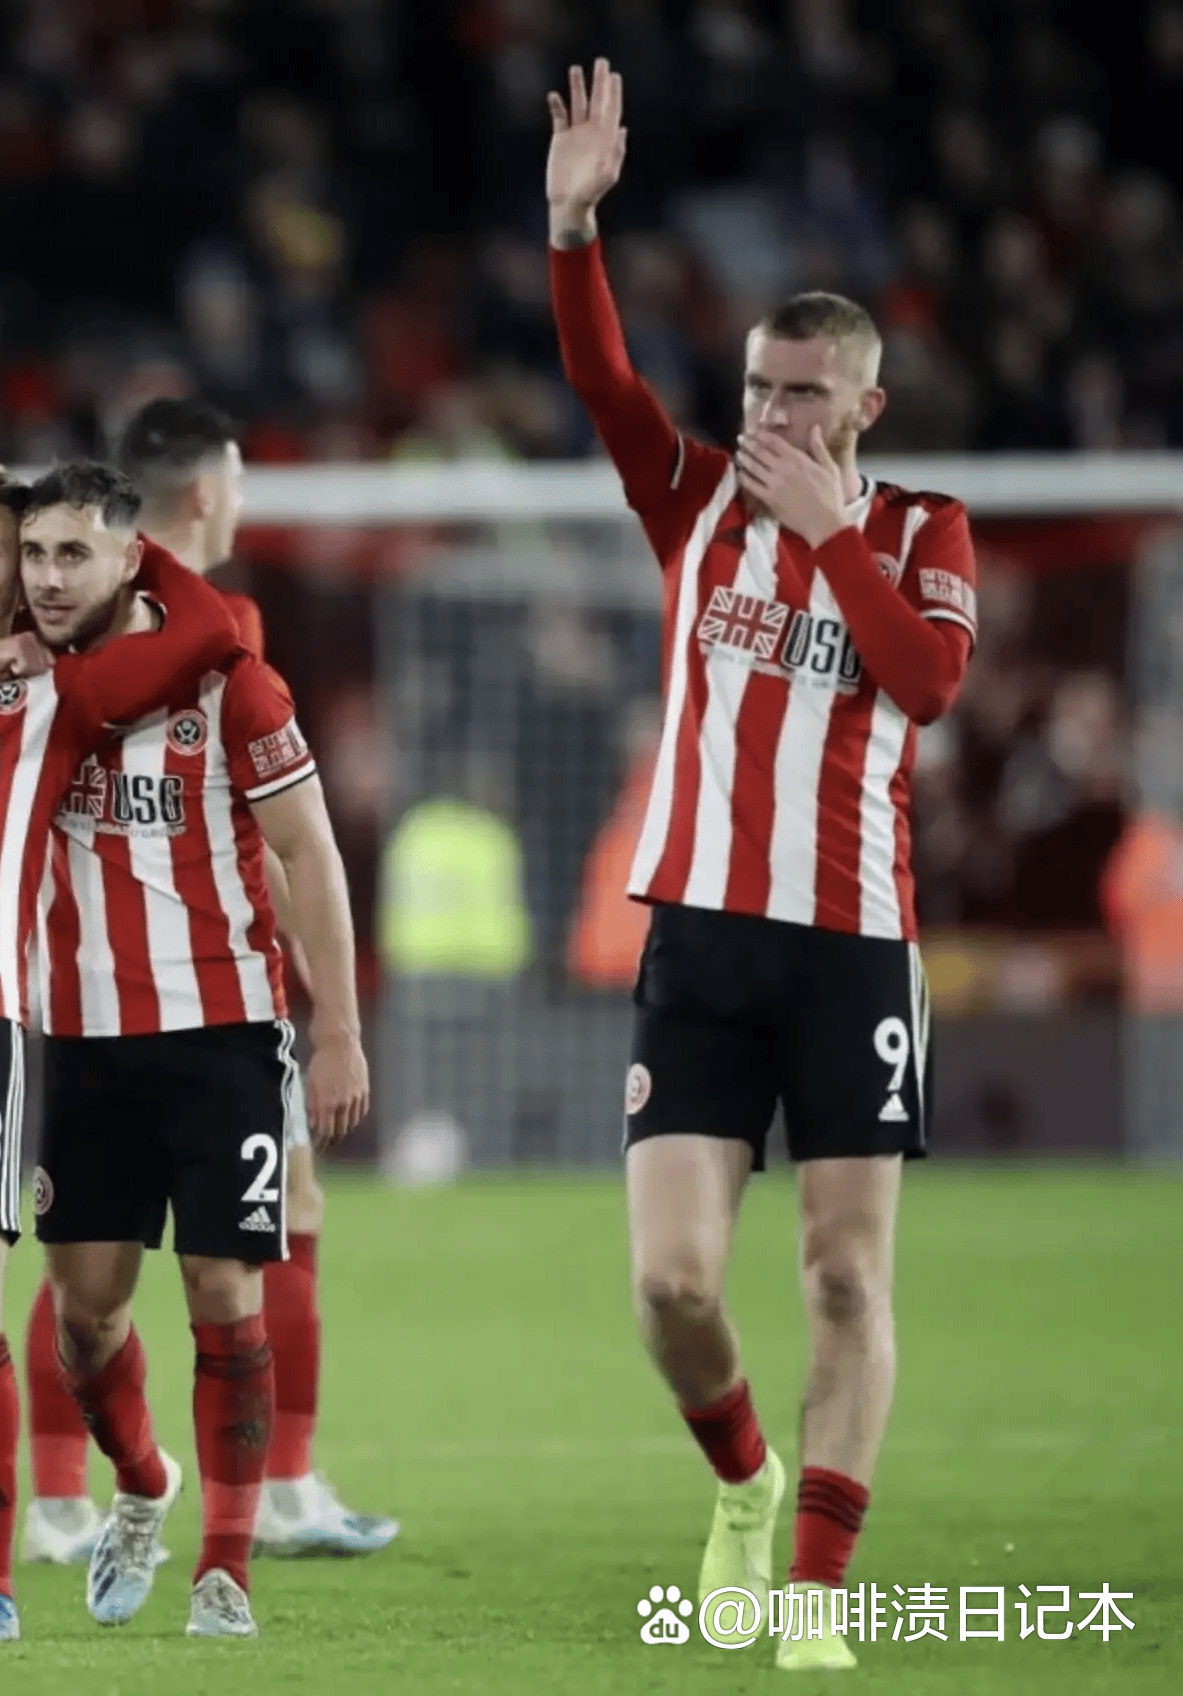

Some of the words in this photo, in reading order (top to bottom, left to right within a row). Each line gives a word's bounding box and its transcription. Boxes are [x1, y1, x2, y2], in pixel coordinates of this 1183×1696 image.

[110, 769, 184, 827] USG
[873, 1016, 910, 1091] 9
[240, 1132, 279, 1202] 2
